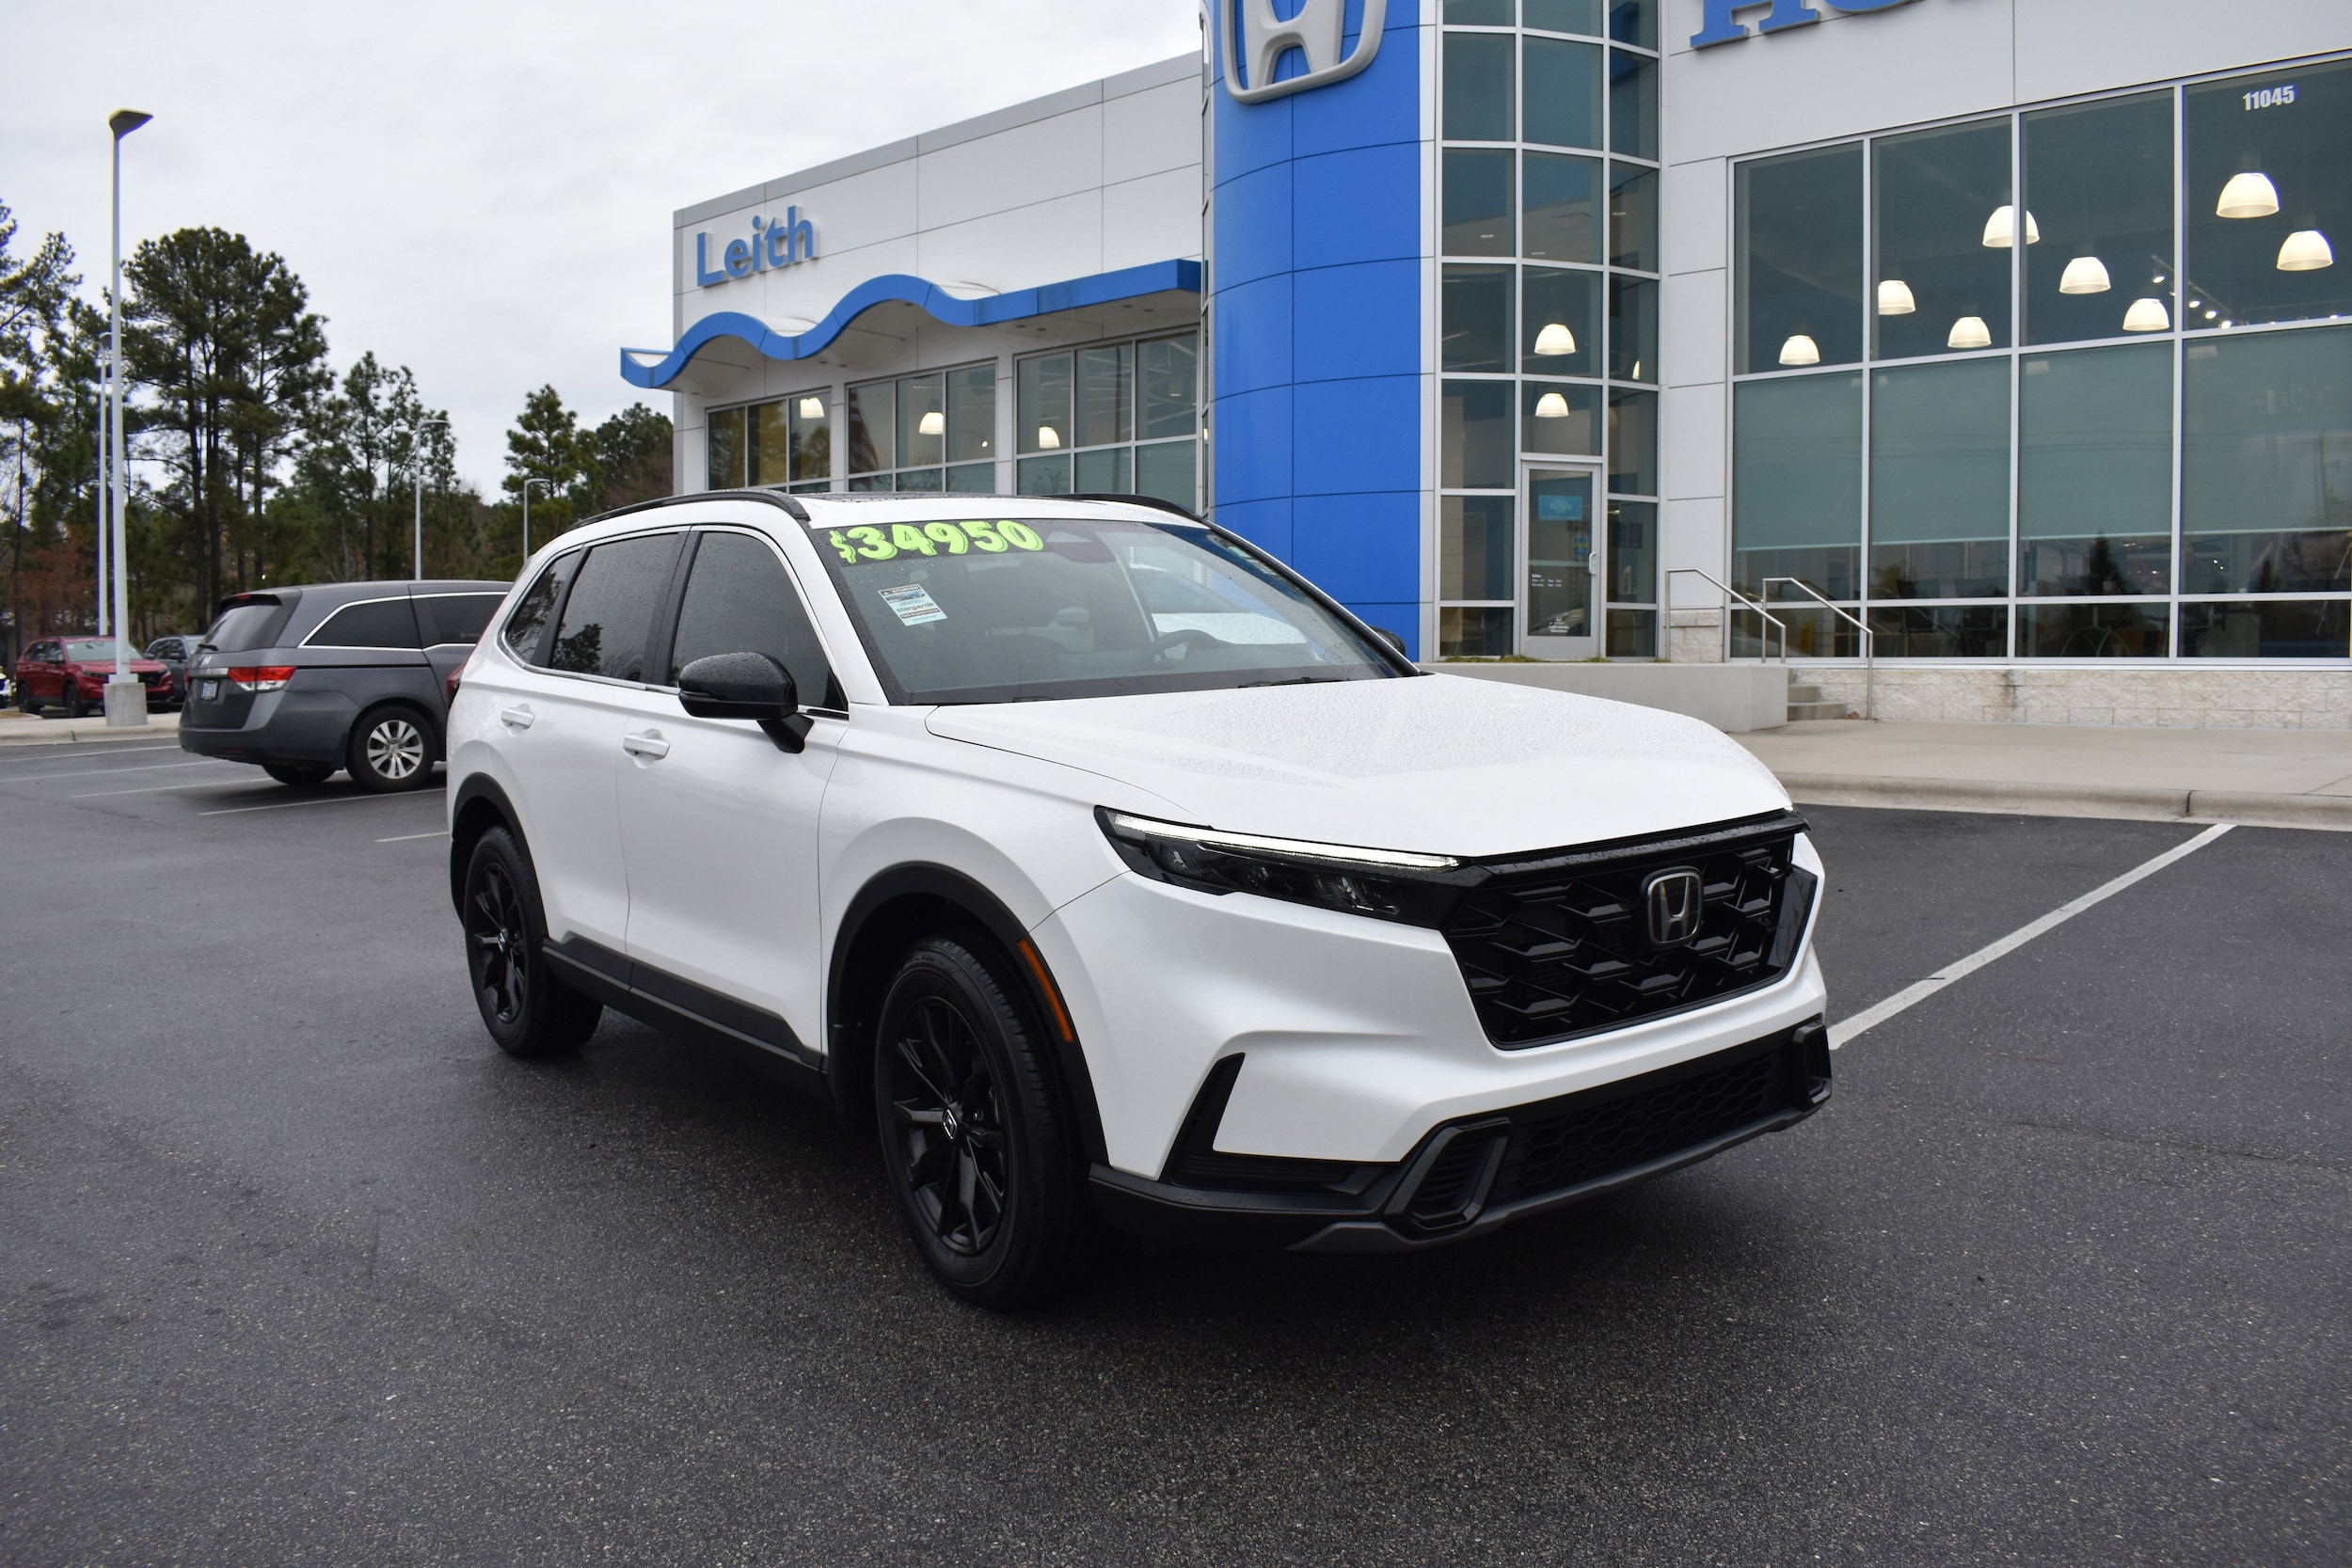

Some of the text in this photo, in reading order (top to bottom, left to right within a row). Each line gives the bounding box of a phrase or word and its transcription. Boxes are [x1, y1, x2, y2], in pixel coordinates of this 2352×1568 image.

[2242, 85, 2296, 111] 11045
[696, 204, 817, 288] Leith
[829, 519, 1044, 564] $34950
